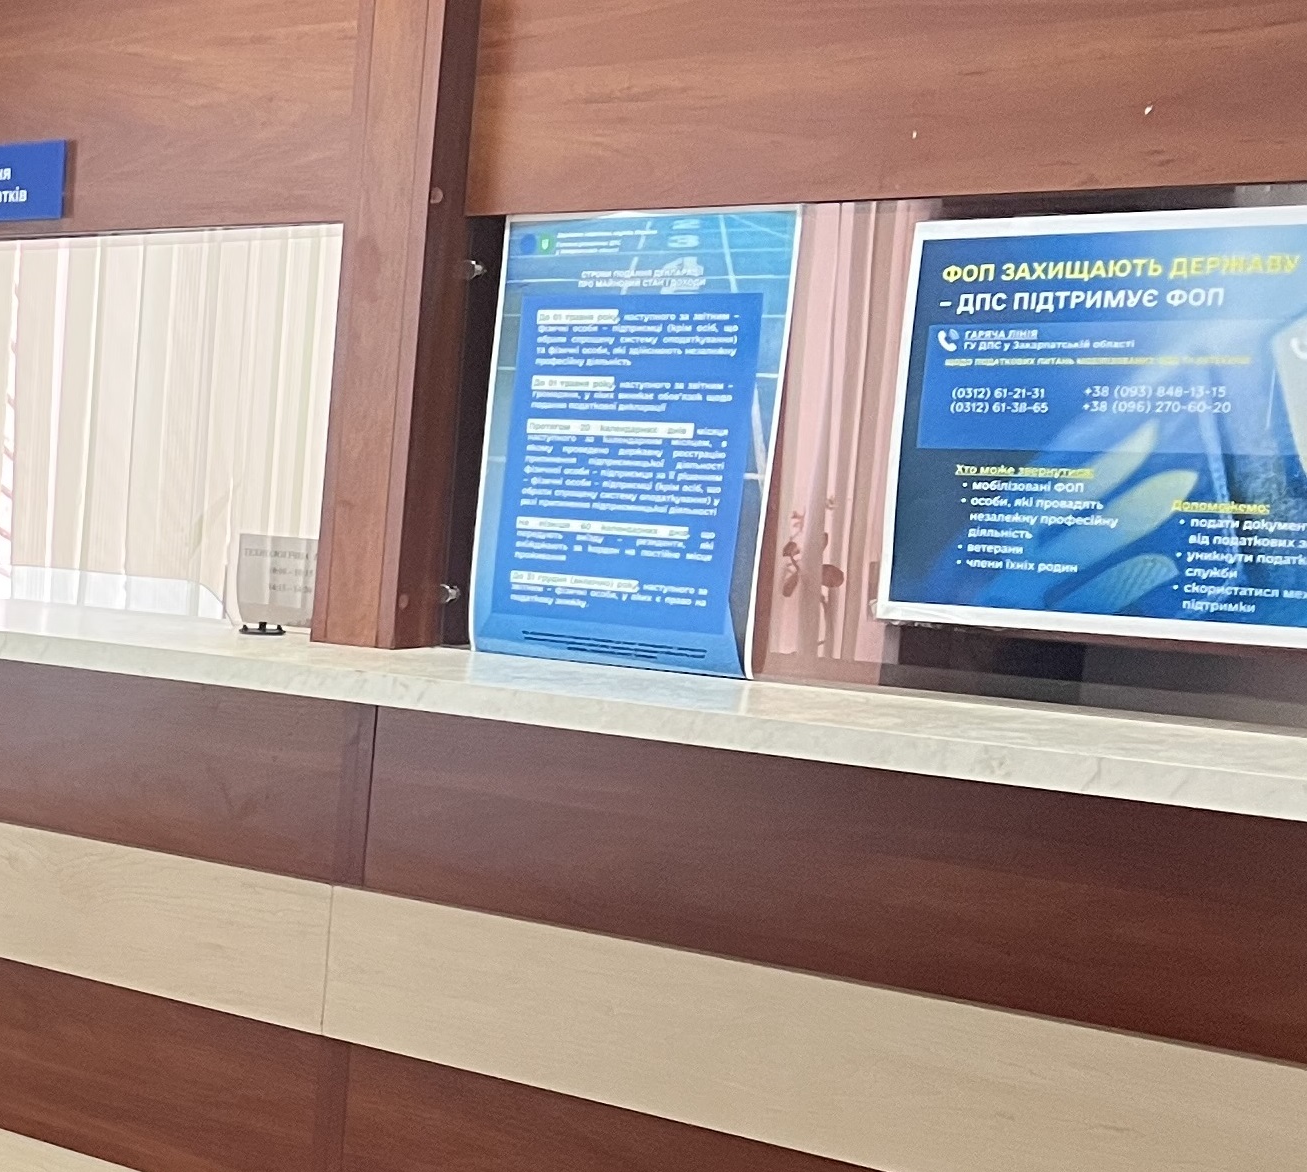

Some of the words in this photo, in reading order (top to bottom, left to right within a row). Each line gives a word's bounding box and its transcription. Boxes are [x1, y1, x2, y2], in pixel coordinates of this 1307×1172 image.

[942, 263, 995, 283] ФОП
[1001, 258, 1163, 281] ЗАХИЩАЮТЬ
[1168, 253, 1300, 280] ДЕРЖАВУ
[956, 293, 1008, 315] ДПС
[1013, 288, 1159, 313] ПІДТРИМУЄ
[1165, 287, 1224, 306] ФОП
[963, 341, 977, 350] ГУ
[950, 387, 991, 401] (0312)
[993, 386, 1045, 399] 61-21-31
[1083, 386, 1110, 398] +38
[949, 402, 990, 415] (0312)
[1081, 401, 1108, 414] +38
[1154, 401, 1231, 415] 270-60-20
[955, 464, 977, 475] Хто
[980, 465, 1015, 476] може
[972, 480, 1051, 492] мобілізовані
[1053, 482, 1084, 493] ФОП
[970, 496, 1011, 508] особи,
[1014, 497, 1034, 507] які
[1035, 499, 1104, 510] провадять
[969, 513, 1037, 525] незалежну
[1040, 514, 1119, 529] професійну
[1190, 518, 1239, 529] подати
[1242, 519, 1307, 533] докумен
[967, 526, 1033, 539] діяльність
[1188, 533, 1210, 546] від
[1212, 535, 1296, 548] податкових
[966, 543, 1024, 555] ветерани
[1186, 551, 1253, 564] уникнути
[966, 559, 1003, 569] члени
[1005, 559, 1035, 571] їхніх
[1037, 562, 1078, 574] родин
[1184, 567, 1238, 579] служби
[1182, 599, 1256, 613] підтримки
